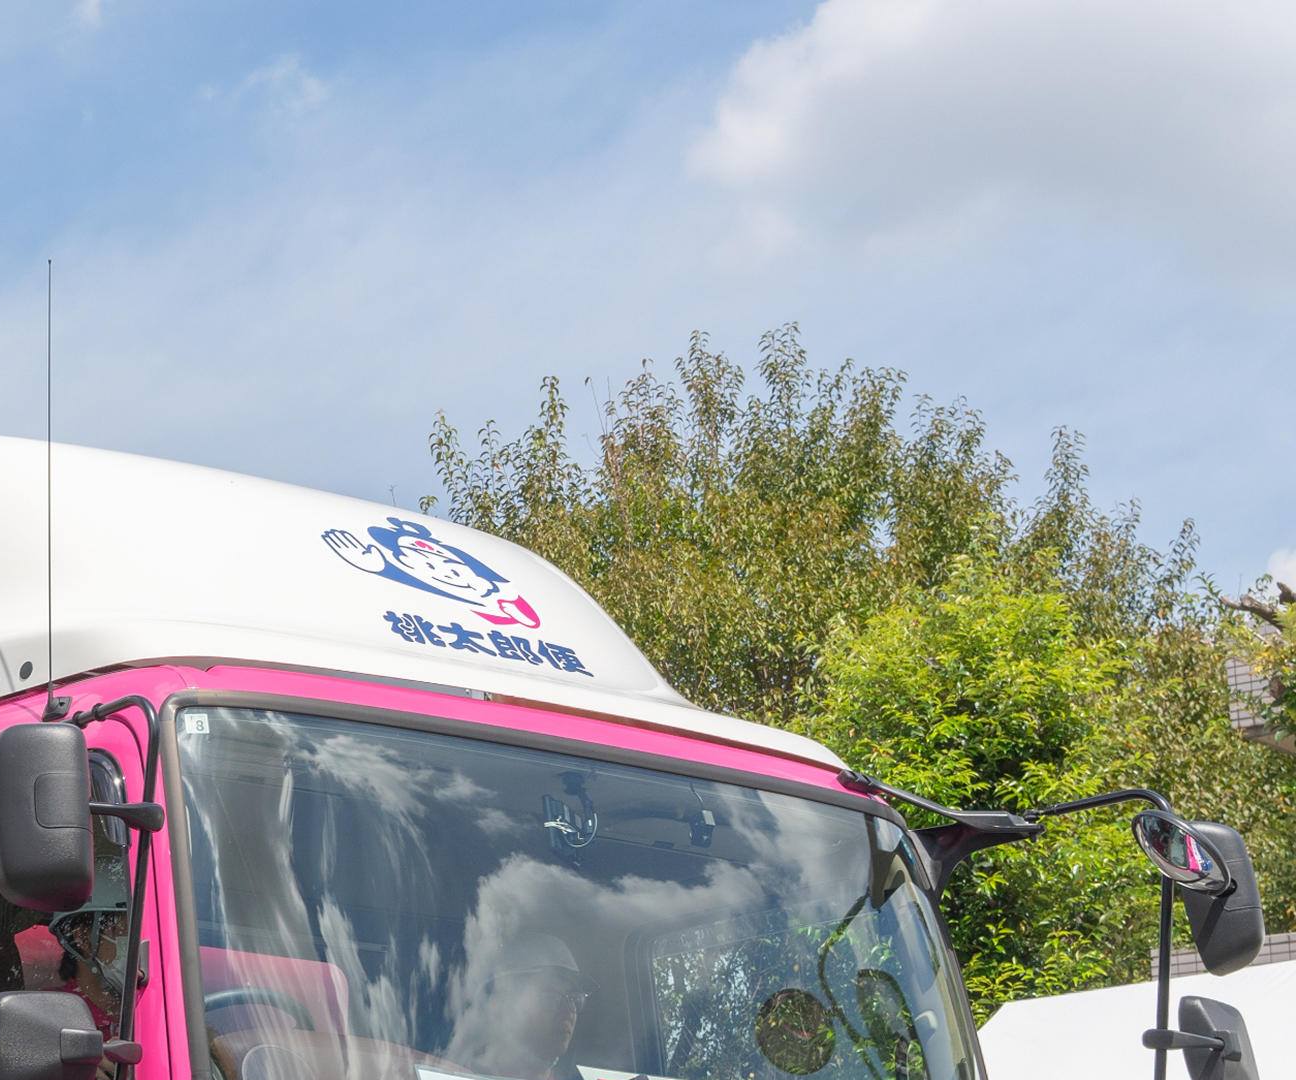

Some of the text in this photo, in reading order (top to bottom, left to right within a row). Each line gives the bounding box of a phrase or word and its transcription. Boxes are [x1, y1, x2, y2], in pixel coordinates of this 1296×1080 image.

[383, 611, 595, 678] 桃太郎便
[196, 720, 204, 731] 8
